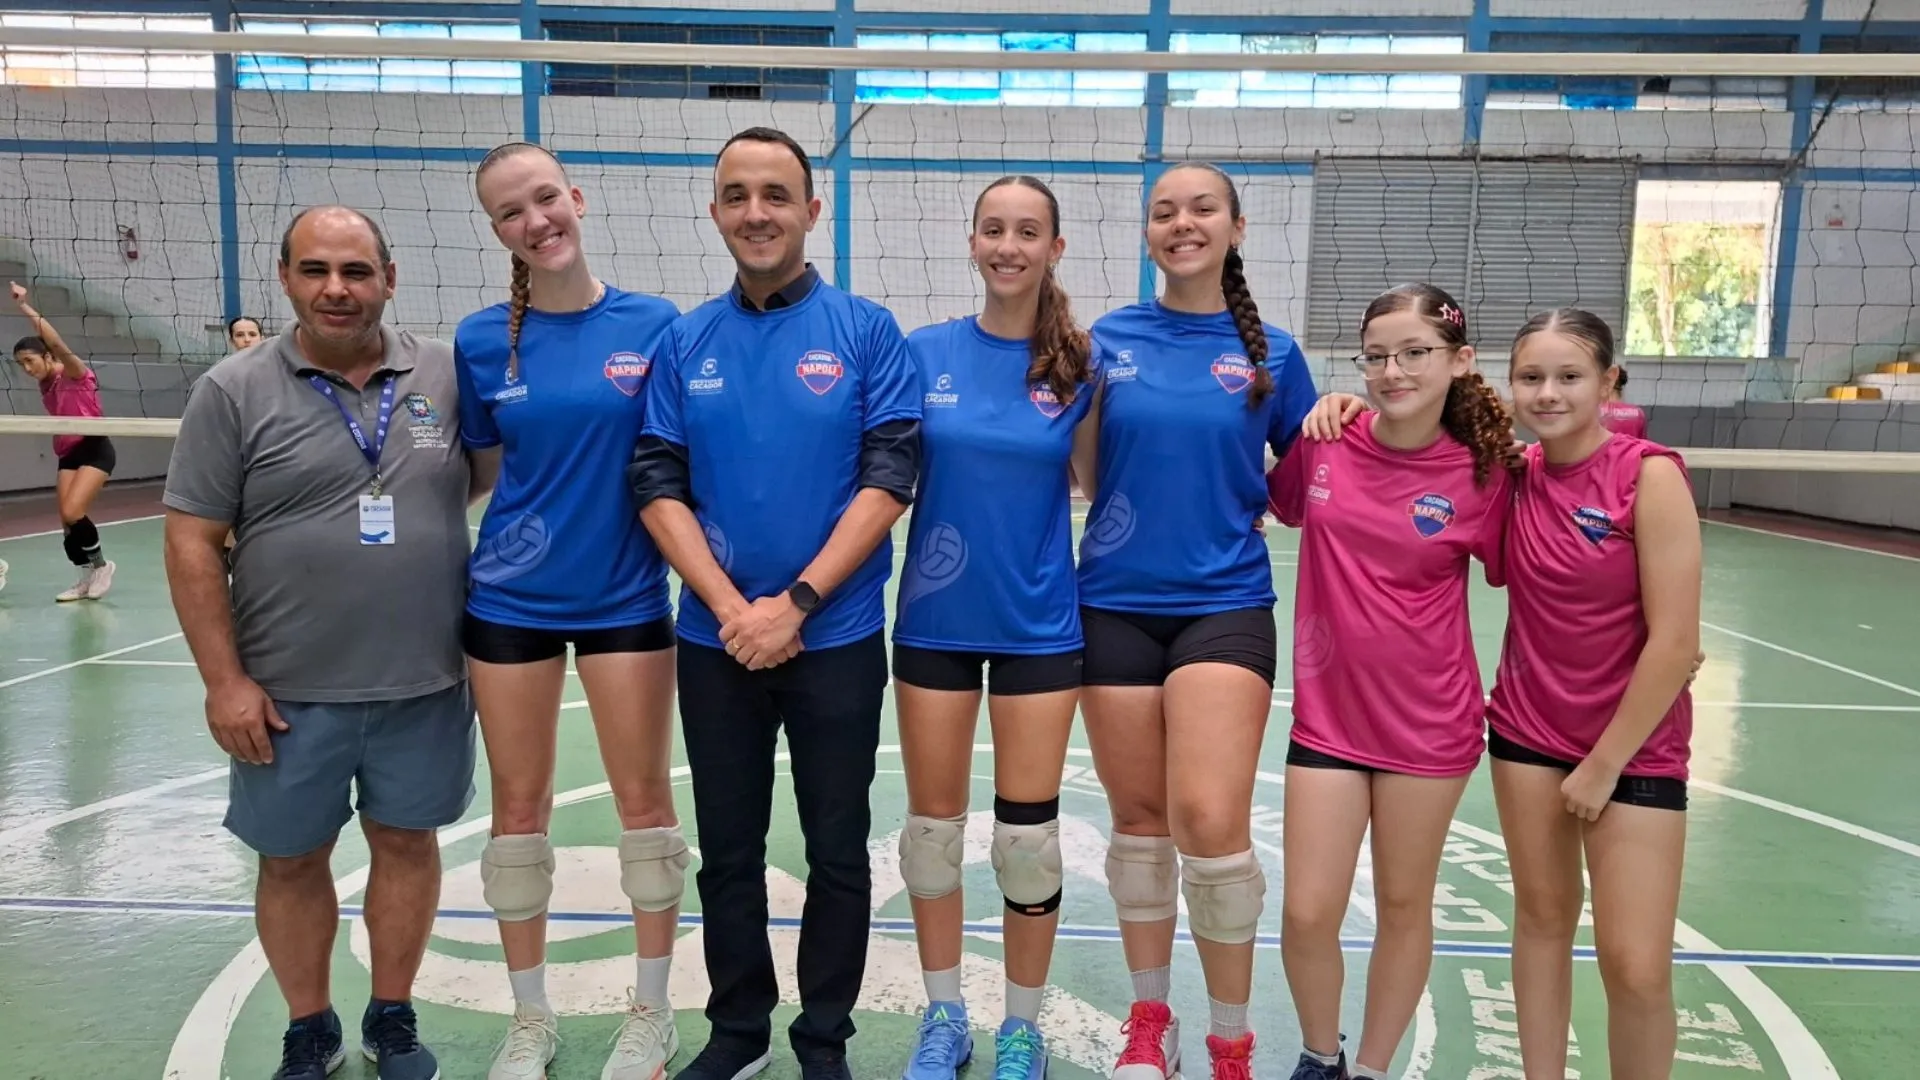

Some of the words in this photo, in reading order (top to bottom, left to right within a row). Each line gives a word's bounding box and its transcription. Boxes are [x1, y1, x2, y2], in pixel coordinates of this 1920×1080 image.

[611, 364, 645, 377] NAPOLI
[803, 363, 837, 376] NAPOLI
[1217, 364, 1251, 379] NAPOLI
[1415, 504, 1449, 523] NAPOLI
